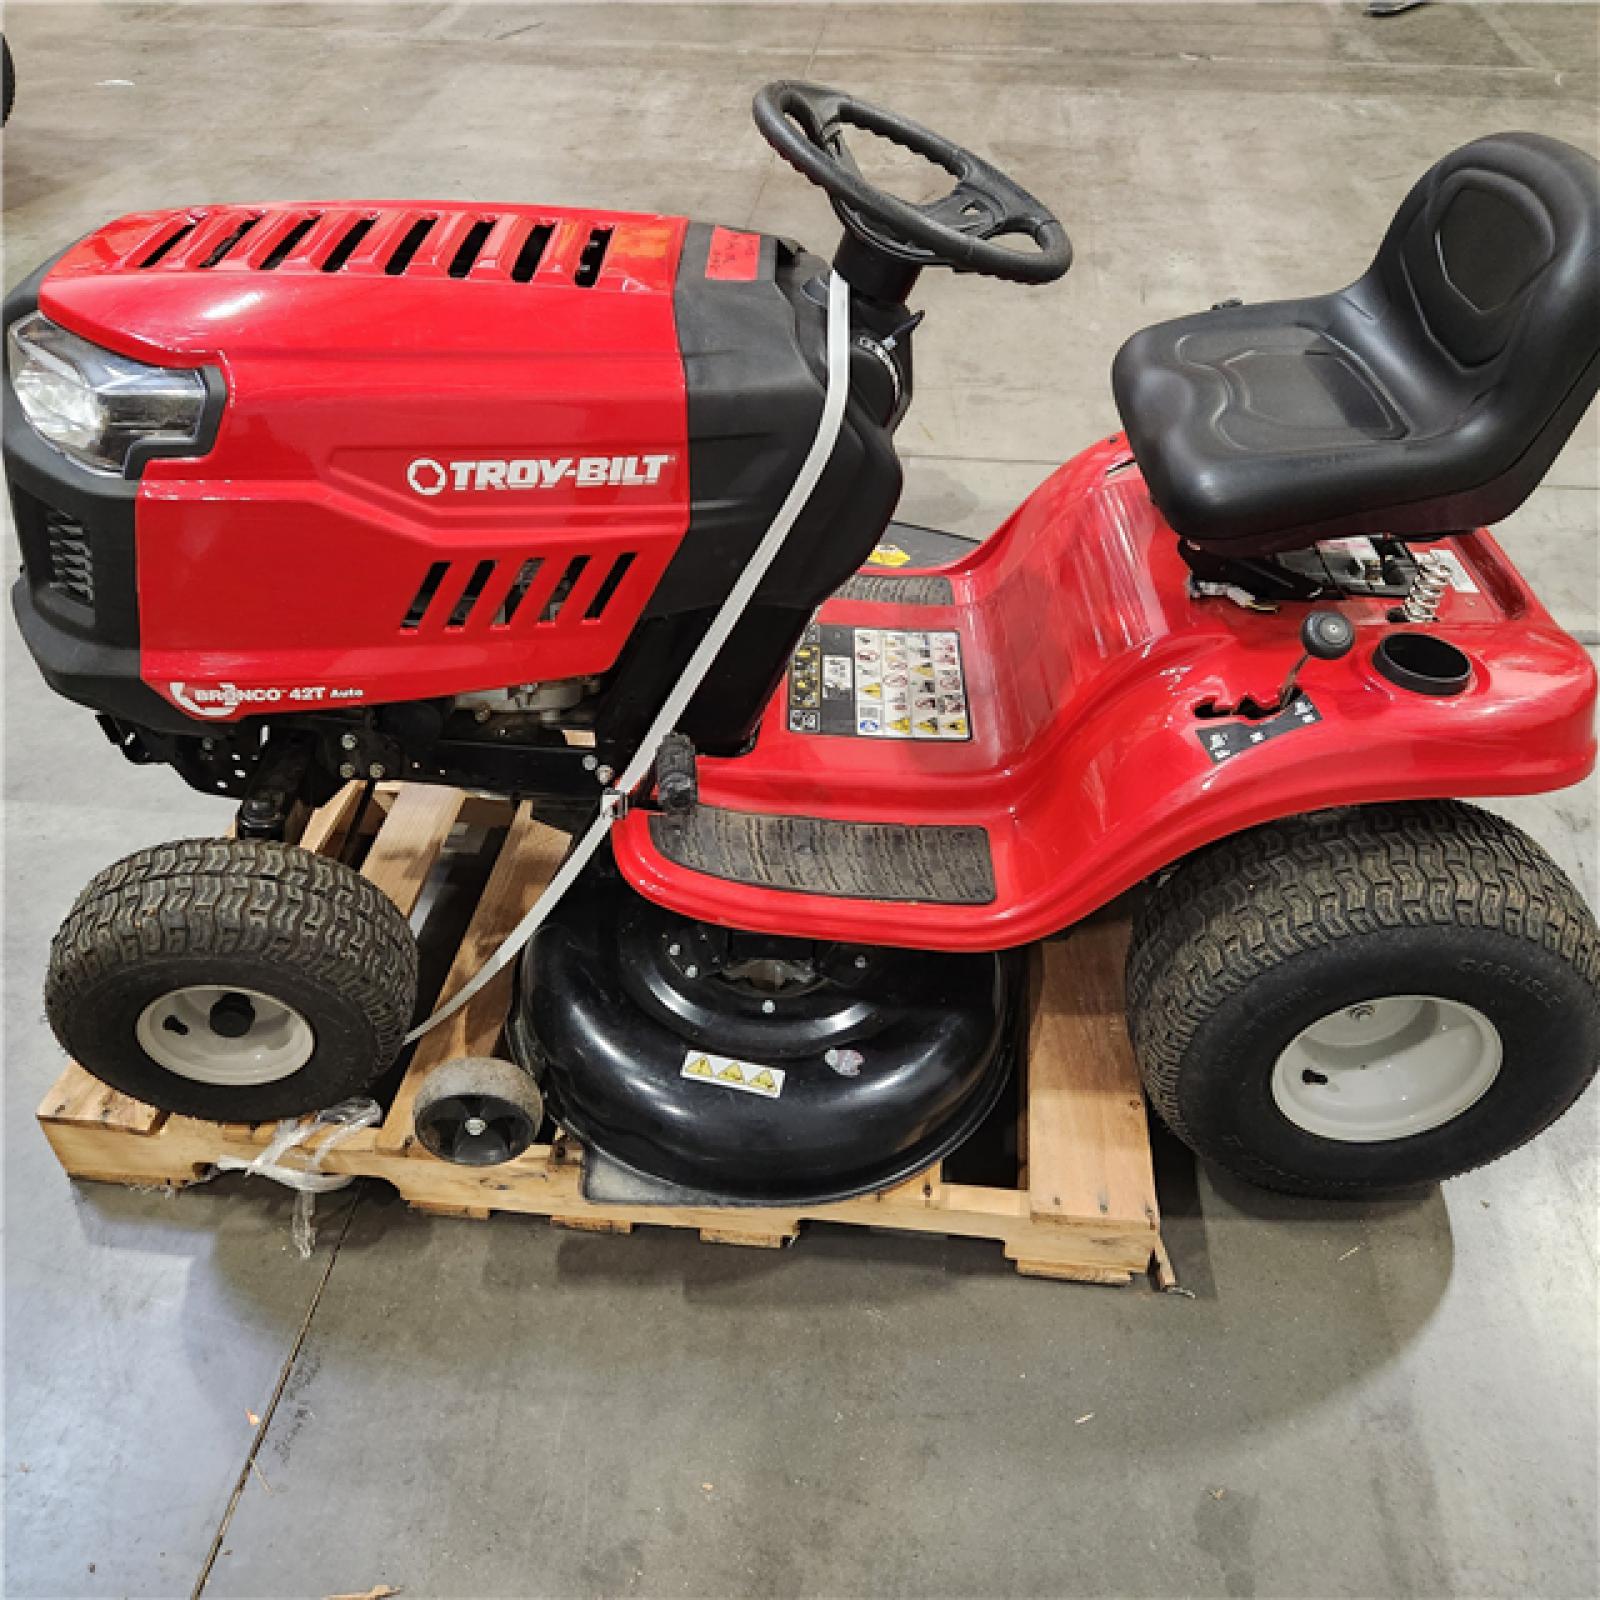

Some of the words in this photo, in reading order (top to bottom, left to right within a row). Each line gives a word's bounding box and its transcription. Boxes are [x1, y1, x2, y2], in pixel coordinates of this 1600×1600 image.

[449, 454, 668, 491] TROY-BILT
[194, 683, 281, 706] BRONCO
[289, 687, 326, 701] 42T
[330, 688, 364, 698] Auto
